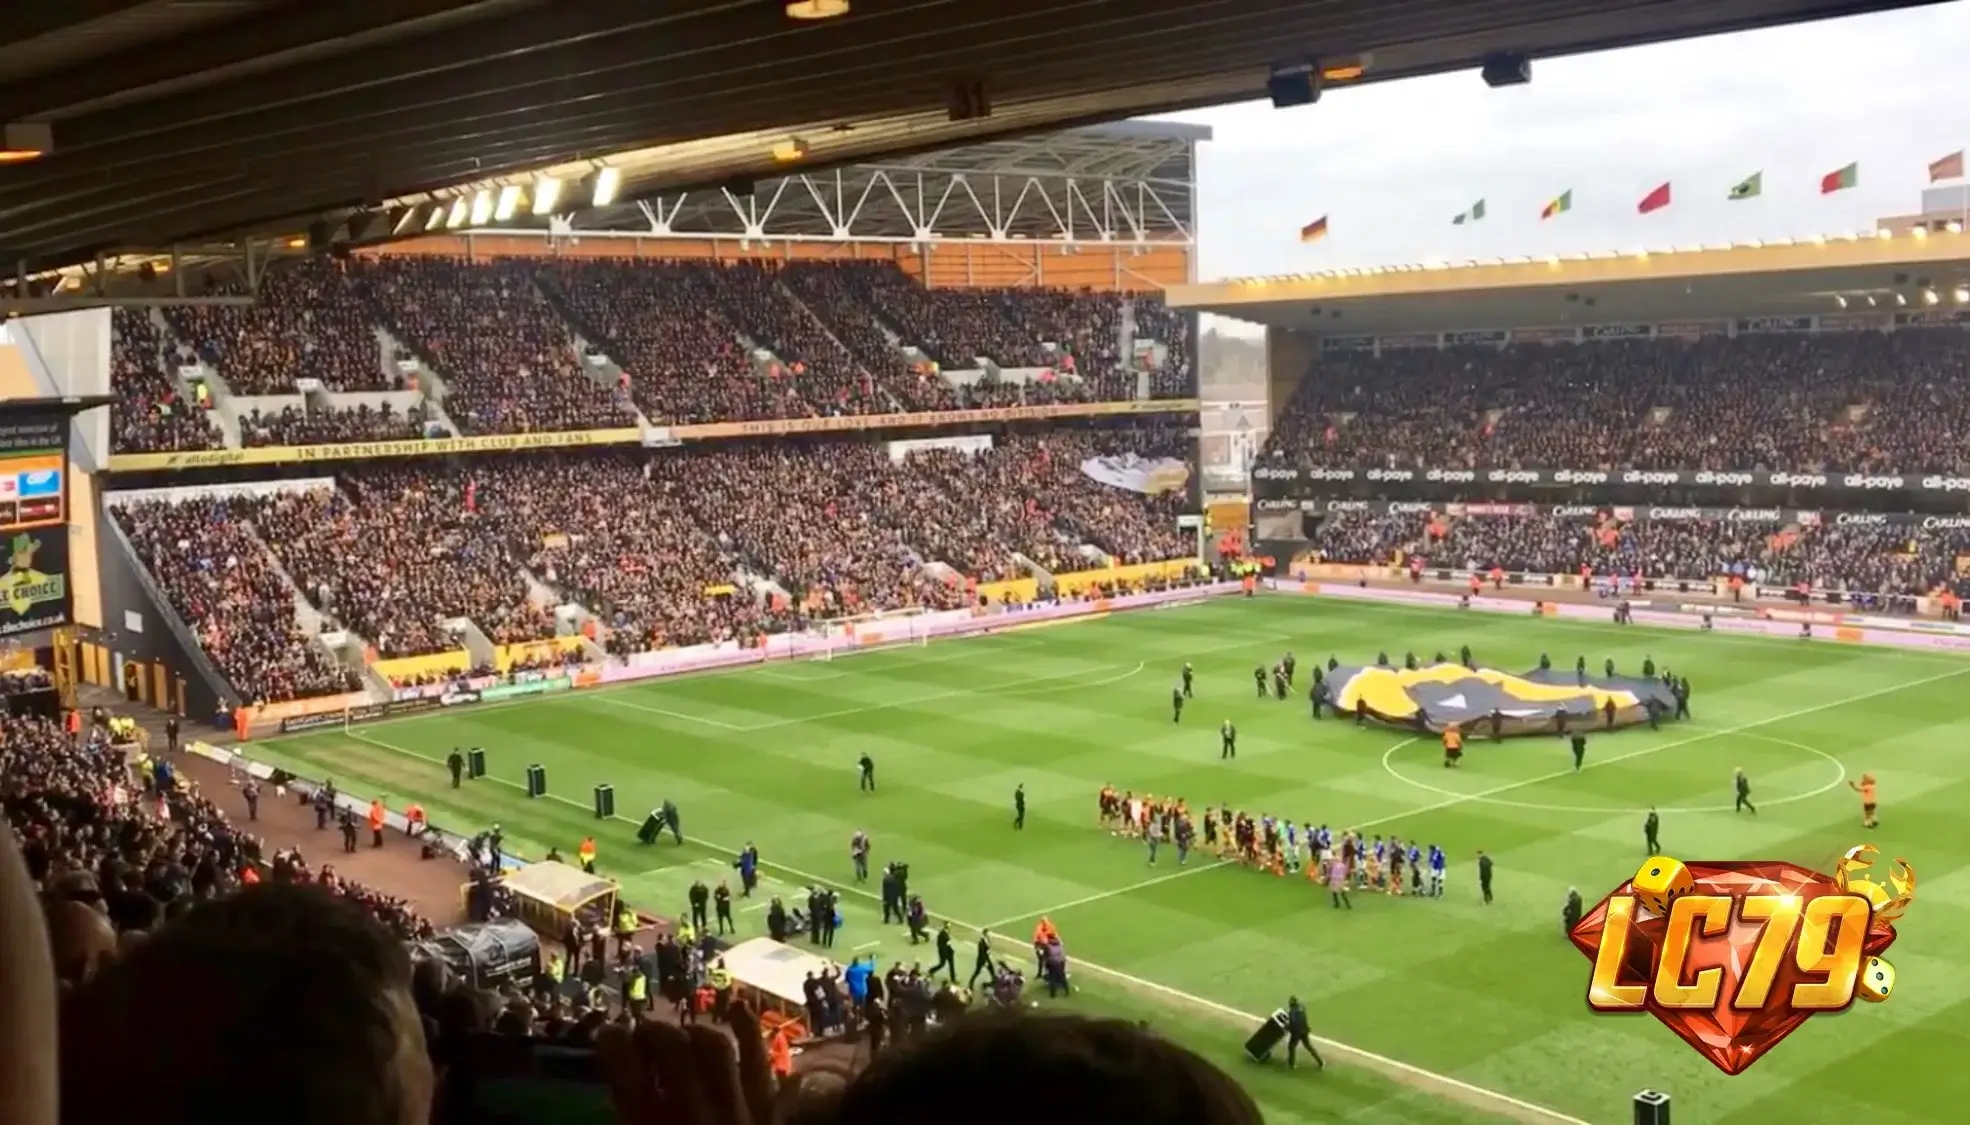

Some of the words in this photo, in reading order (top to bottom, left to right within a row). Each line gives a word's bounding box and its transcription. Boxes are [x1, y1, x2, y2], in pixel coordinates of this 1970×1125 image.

[297, 450, 316, 460] IN
[322, 442, 429, 457] PARTNERSHIP
[434, 439, 476, 451] WITH
[481, 436, 518, 449] CLUB
[523, 434, 554, 446] AND
[558, 433, 592, 443] FANS
[13, 582, 56, 599] CHOICE
